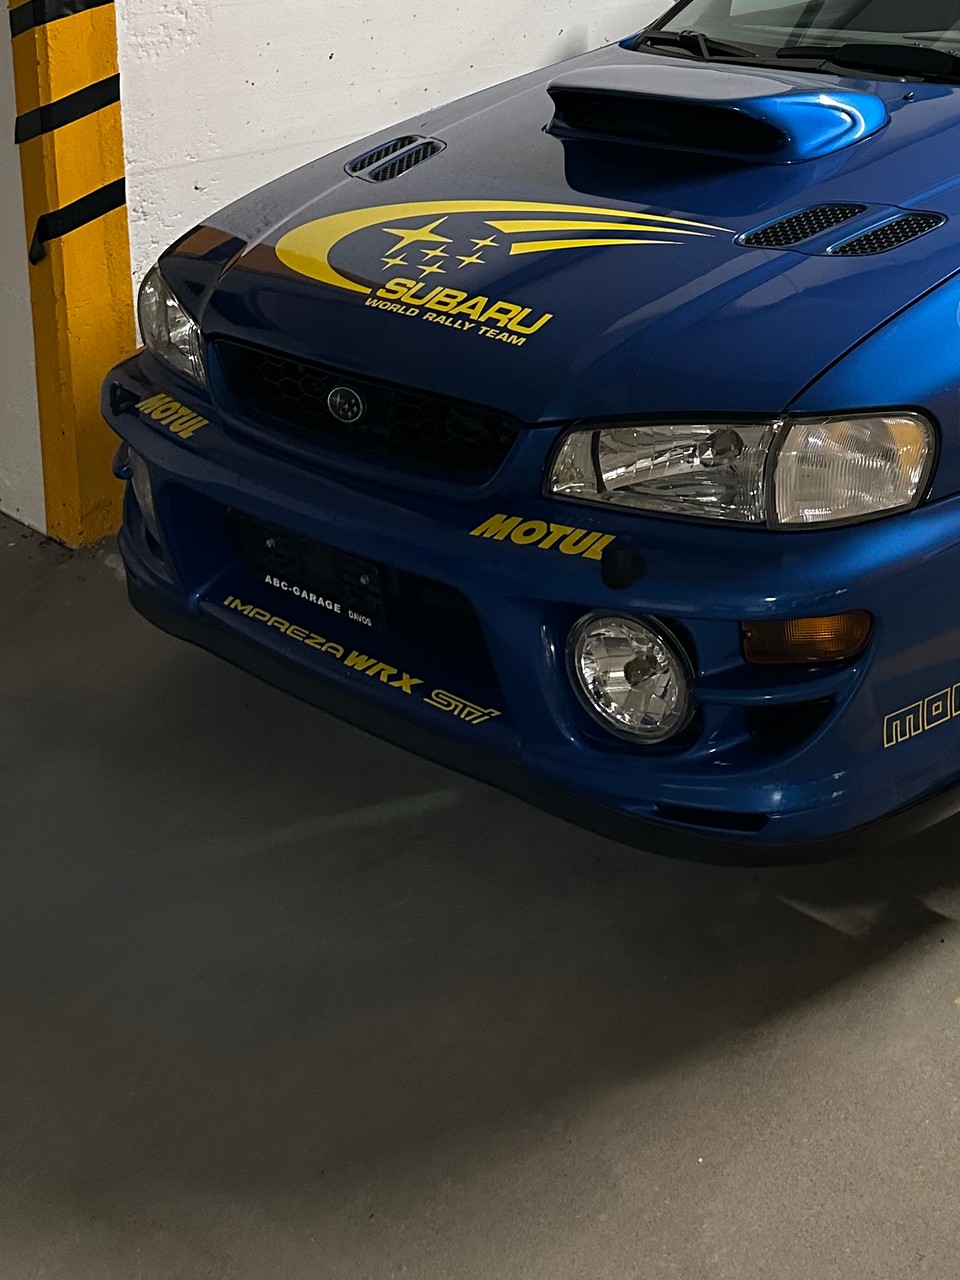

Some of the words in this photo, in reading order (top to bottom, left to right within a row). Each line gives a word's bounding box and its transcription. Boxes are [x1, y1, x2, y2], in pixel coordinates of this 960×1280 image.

[364, 297, 420, 317] WORLD
[422, 312, 477, 331] RALLY
[478, 325, 527, 346] TEAM
[376, 277, 554, 335] SUBARU
[134, 393, 210, 439] MOTUL
[469, 513, 617, 561] MOTUL
[264, 574, 342, 614] ABC-GARAGE
[223, 595, 346, 659] IMPREZA
[344, 650, 425, 695] WRX
